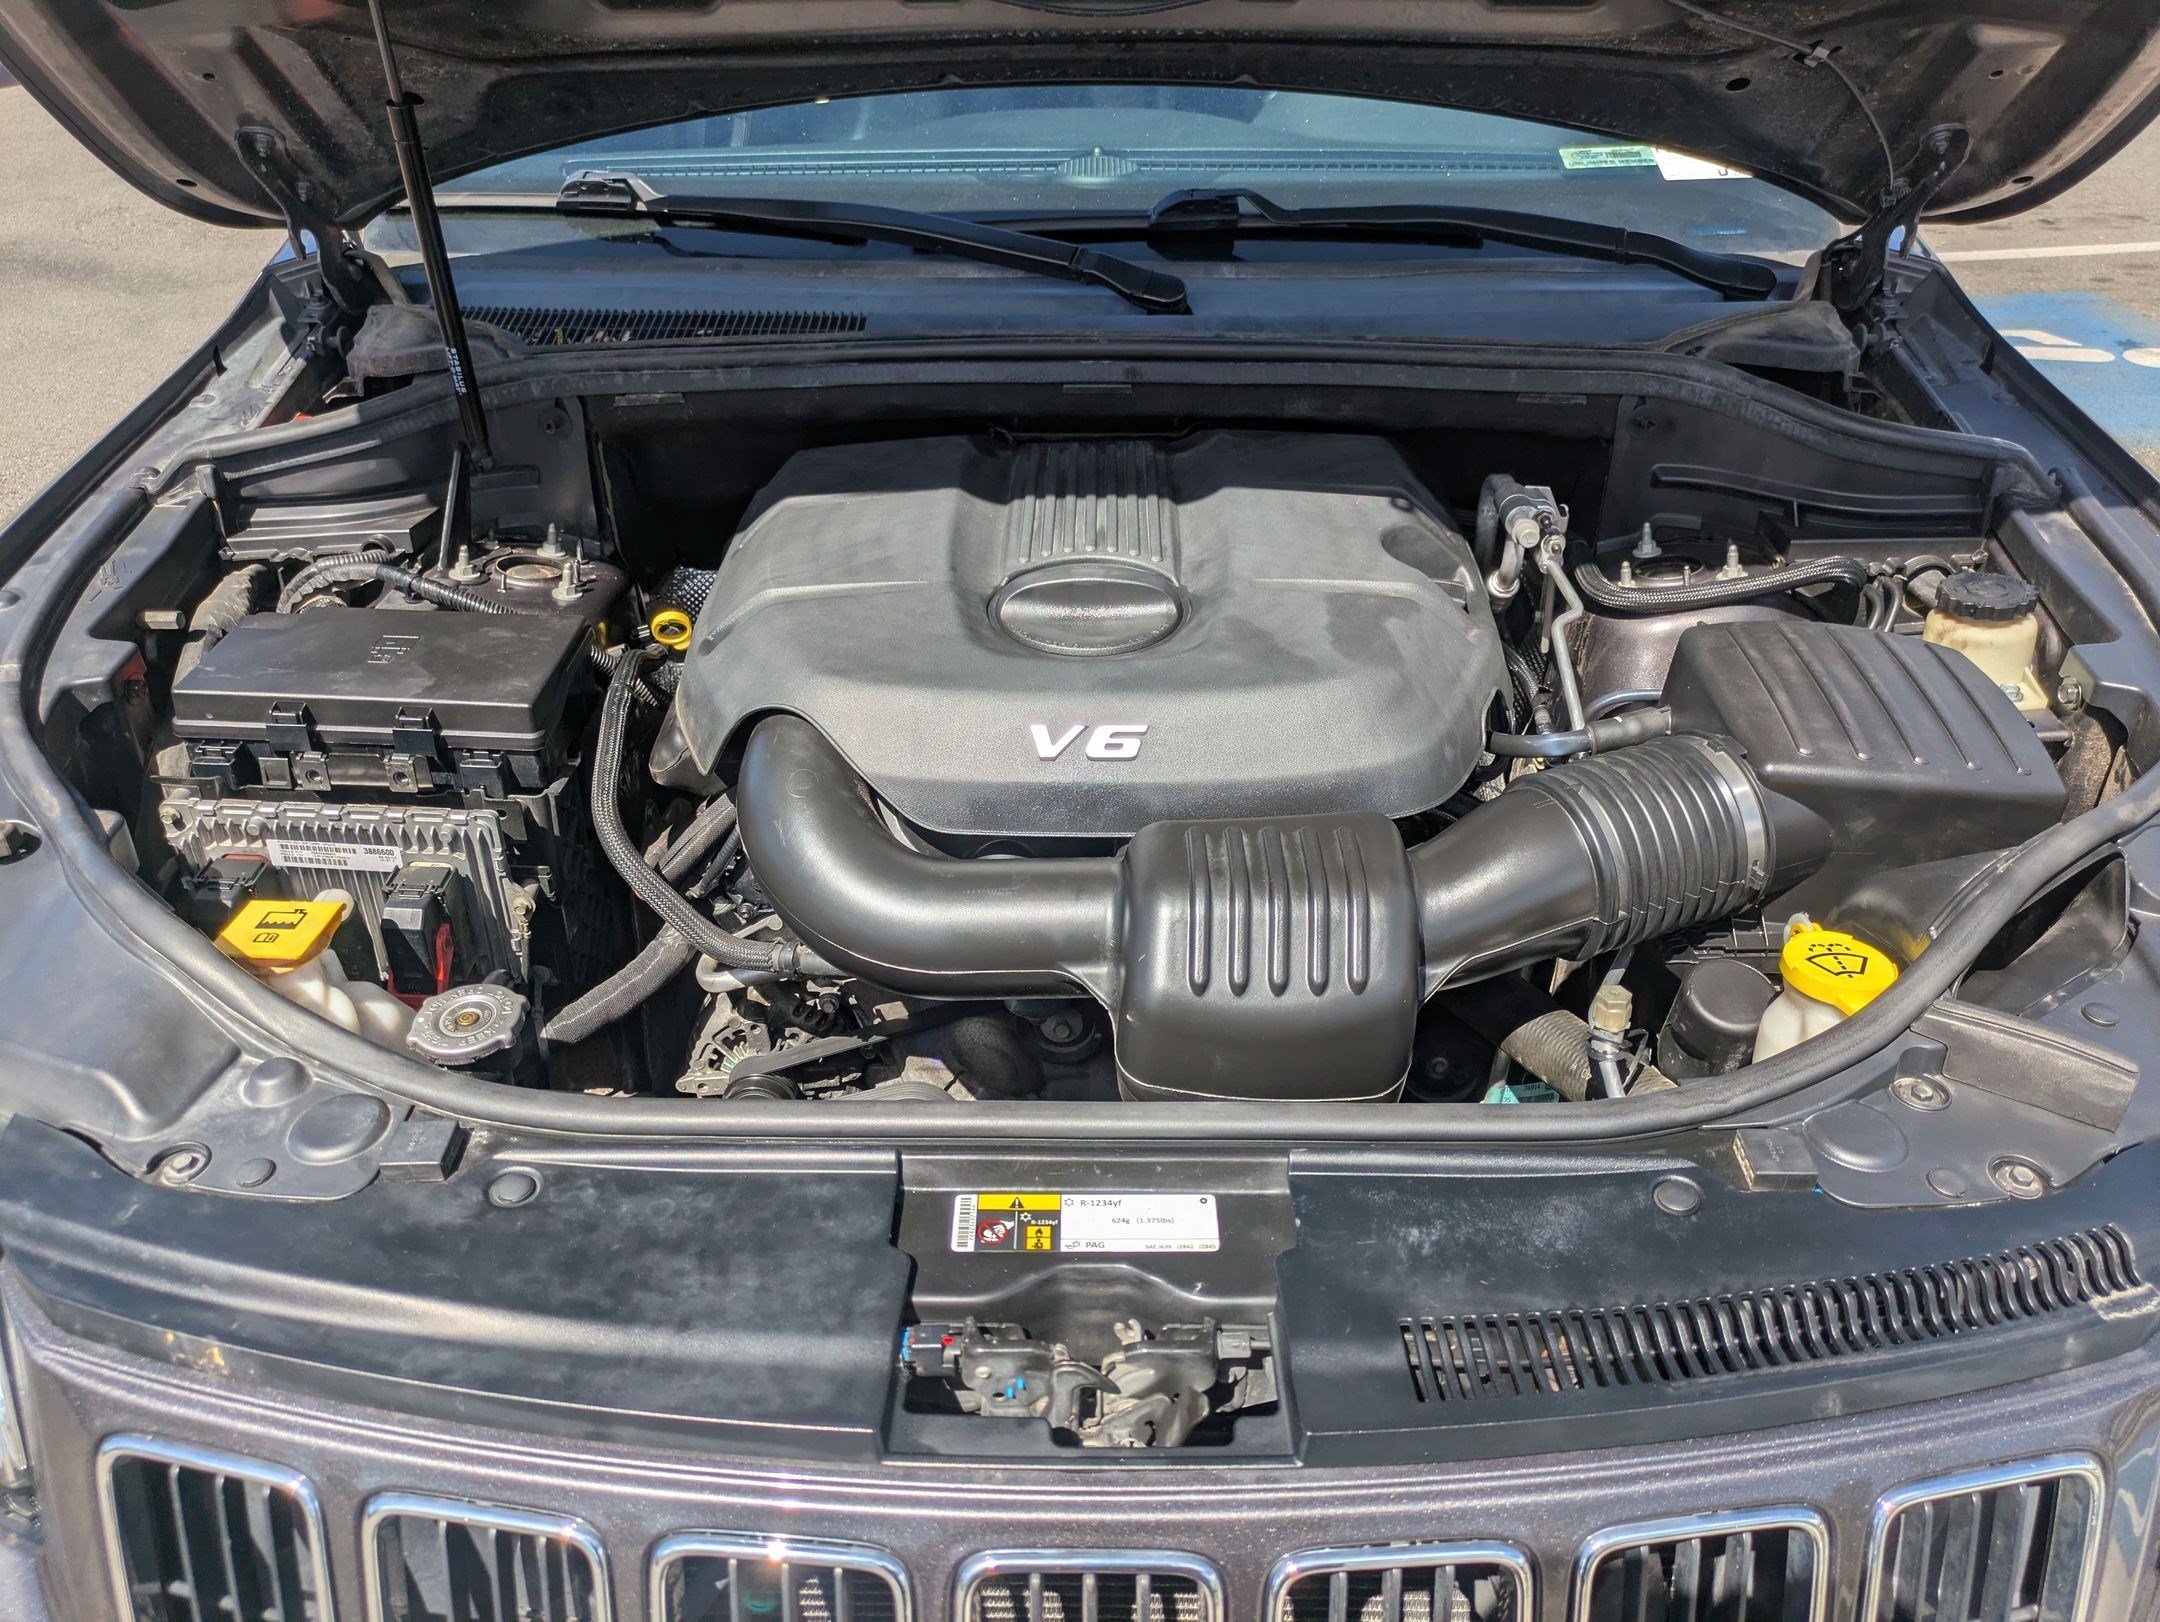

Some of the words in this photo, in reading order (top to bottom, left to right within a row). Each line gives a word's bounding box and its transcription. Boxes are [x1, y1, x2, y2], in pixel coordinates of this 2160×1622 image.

[1030, 725, 1150, 761] V6
[1080, 1199, 1122, 1208] R-1234yf
[1111, 1217, 1130, 1225] 624g
[1136, 1217, 1175, 1225] (1.375lbs)
